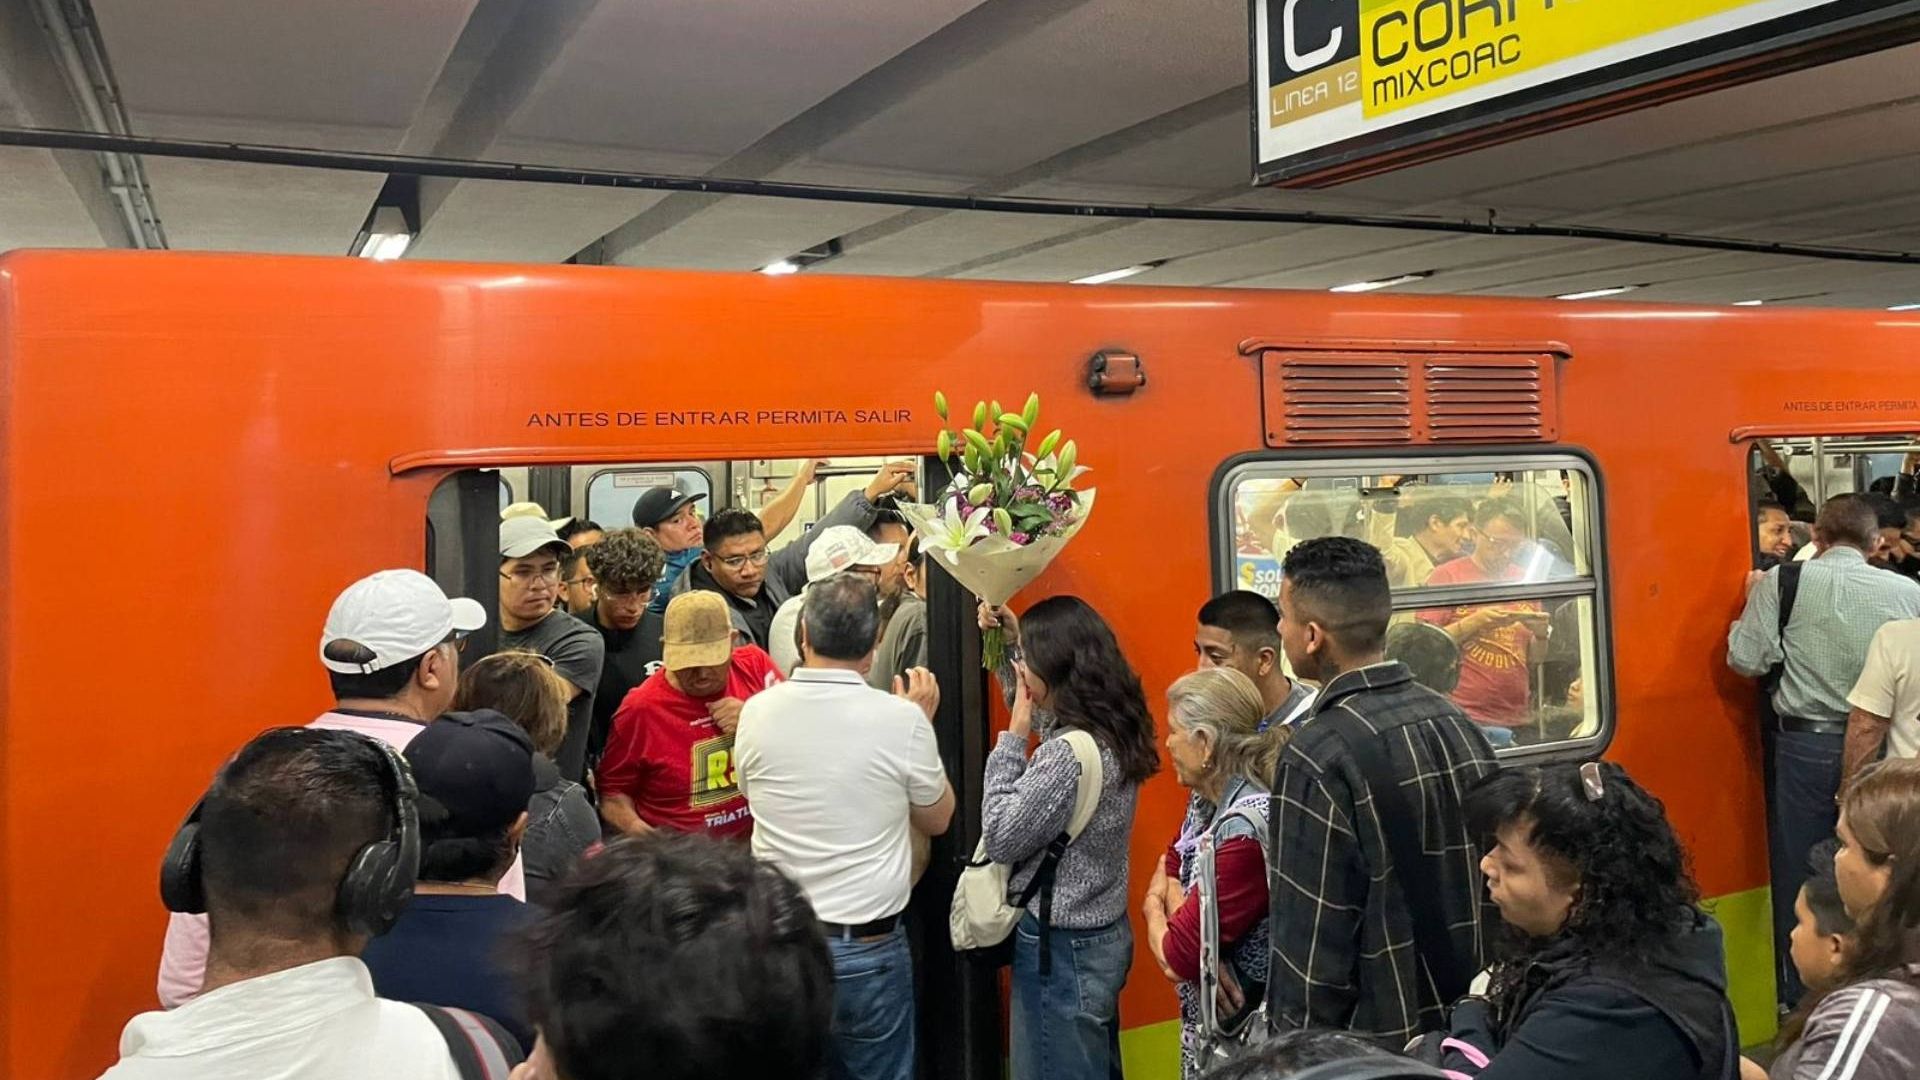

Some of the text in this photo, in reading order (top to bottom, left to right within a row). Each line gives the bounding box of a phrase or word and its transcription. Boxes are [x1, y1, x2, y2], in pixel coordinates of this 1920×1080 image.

[1283, 0, 1343, 72] C
[1373, 34, 1521, 106] MIXCOAC
[1273, 71, 1358, 115] LINEA 12
[527, 409, 911, 427] ANTES DE ENTRAR PERMITA SALIR
[1783, 400, 1919, 412] ANTES DE ENTRAR PERMITA
